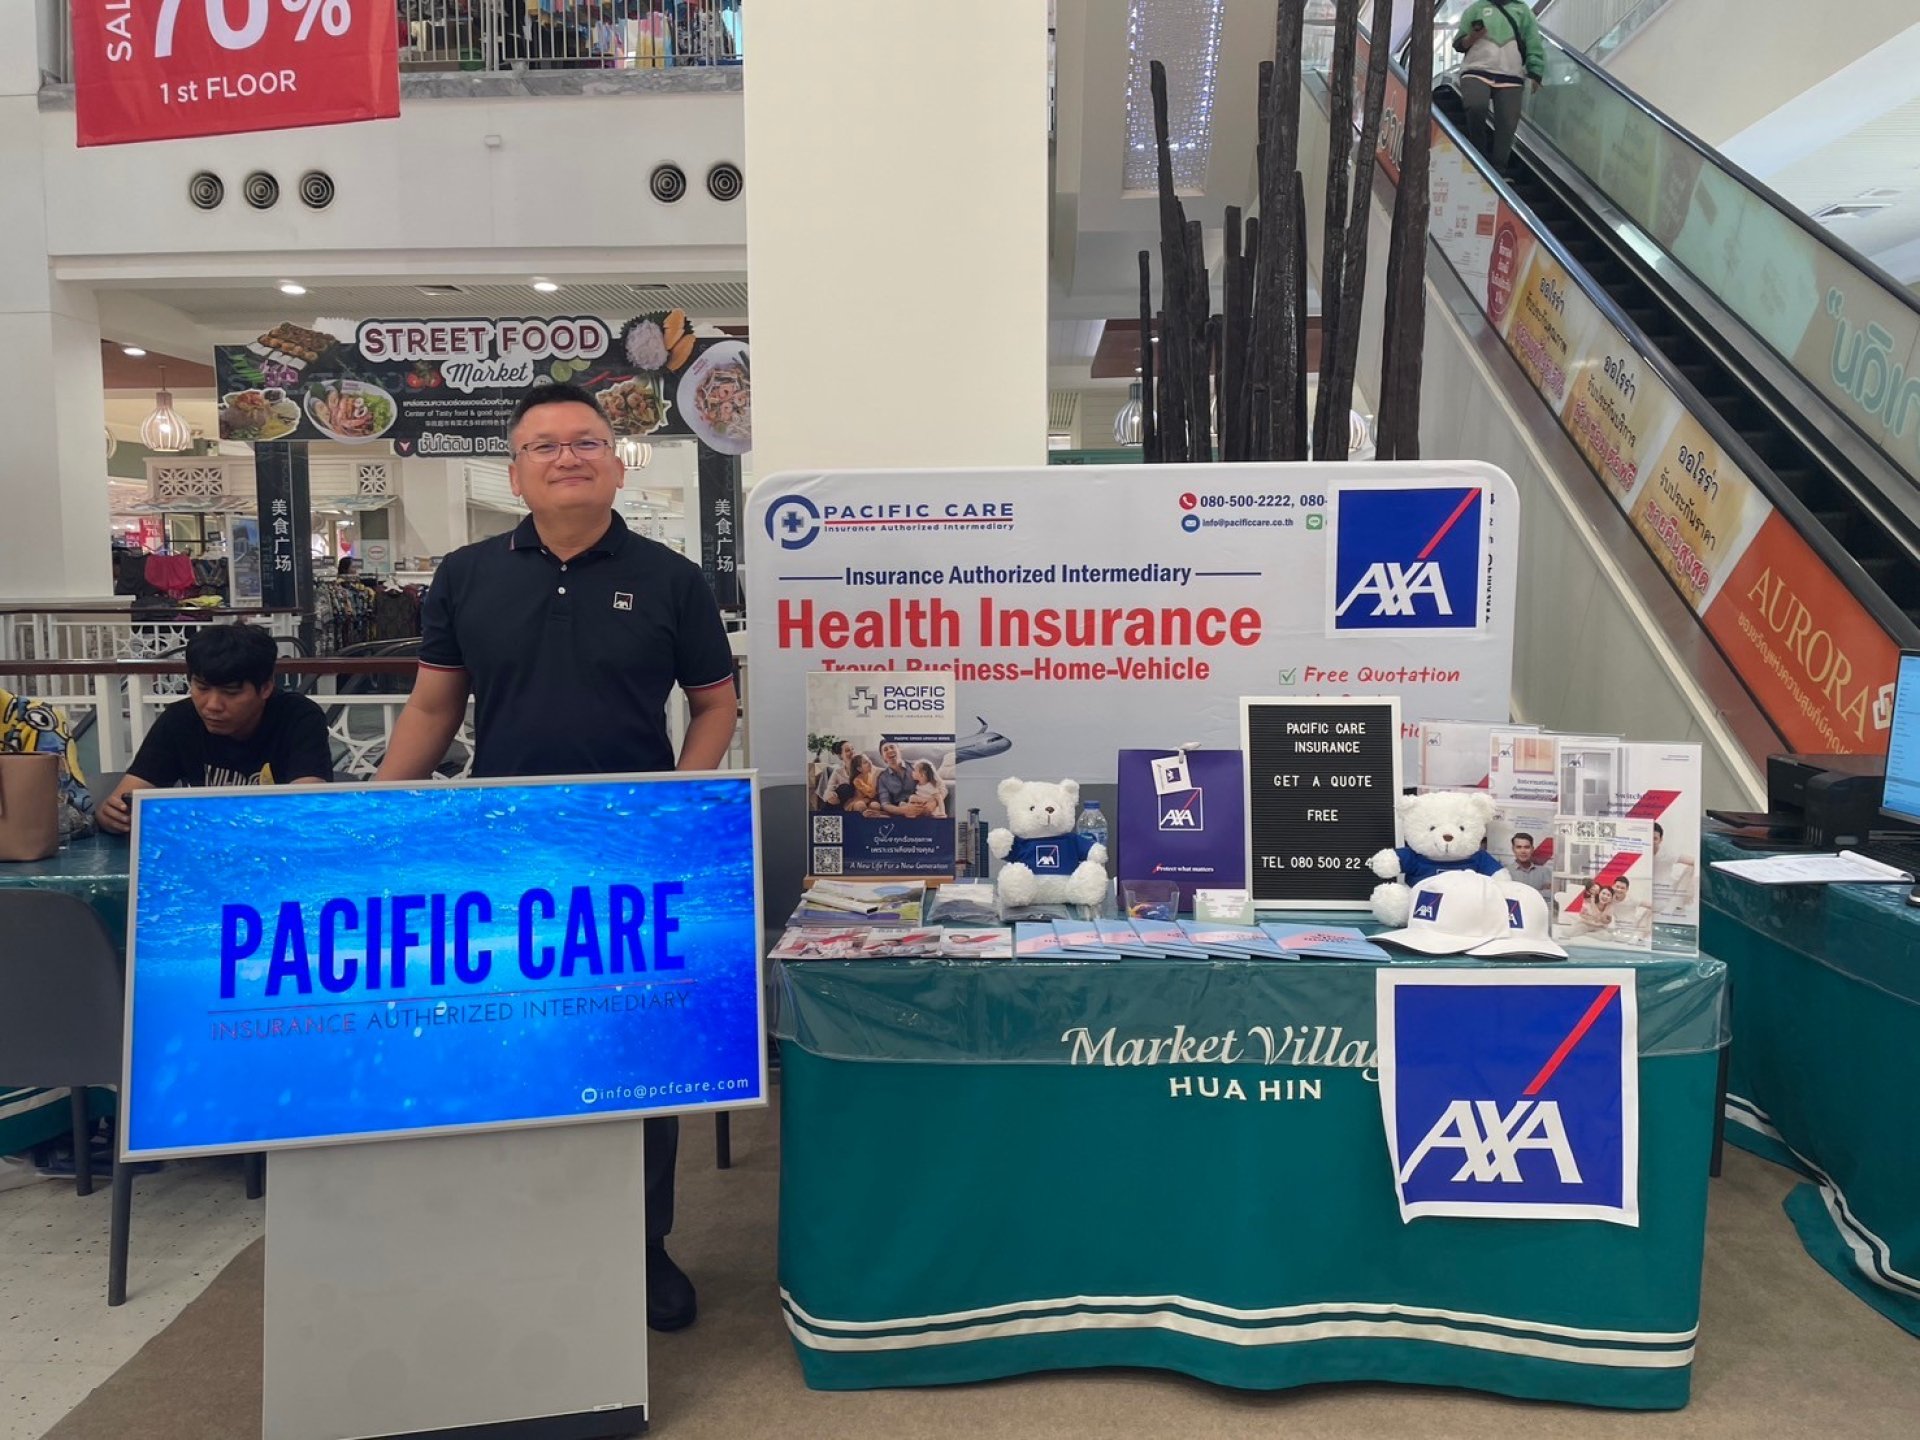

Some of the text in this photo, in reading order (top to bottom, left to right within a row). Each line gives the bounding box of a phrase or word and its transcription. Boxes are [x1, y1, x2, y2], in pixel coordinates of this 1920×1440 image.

[160, 69, 297, 104] 1 st FLOOR
[364, 325, 600, 354] STREET FOOD
[447, 362, 529, 387] Market
[1603, 355, 1636, 403] ออโรร่า
[455, 409, 468, 417] food
[477, 409, 493, 418] good
[476, 438, 486, 451] B
[1678, 445, 1719, 501] ออโรร่า
[823, 502, 1014, 519] PACIFIC CARE
[1200, 495, 1295, 508] 080-500-2222,
[1659, 467, 1716, 551] รับประกันราคา
[880, 524, 940, 532] Authorized
[943, 523, 1014, 531] Intermediary
[1202, 518, 1294, 528] info@pacificcare.co.th
[271, 498, 292, 573] 美食广场
[714, 498, 734, 573] 美食广场
[845, 563, 1191, 586] Insurance Authorized Intermediary
[1335, 562, 1453, 616] AXA
[777, 597, 1262, 649] Health Insurance
[1747, 566, 1869, 744] AURORA
[1303, 665, 1460, 683] Free Quotation
[883, 685, 945, 698] PACIFIC
[883, 699, 945, 711] CROSS
[1286, 722, 1366, 735] PACIFIC CARE
[1294, 741, 1361, 754] INSURANCE
[1273, 775, 1373, 787] GET A QUOTE
[1161, 809, 1195, 826] AXA
[1307, 809, 1339, 822] FREE
[1036, 856, 1055, 865] AXA
[1191, 865, 1215, 873] matters
[1261, 855, 1285, 869] TEL
[1290, 856, 1314, 869] 080
[1317, 856, 1341, 869] 500
[1345, 857, 1361, 869] 22
[219, 880, 687, 999] PACIFIC CARE
[211, 991, 690, 1041] INSURANCE AUTHERIZED INTERMEDIARY
[1061, 1024, 1244, 1067] Market
[600, 1077, 749, 1100] info@pcfcare.com
[1168, 1076, 1322, 1101] HUA HIN
[1399, 1099, 1583, 1184] AXA
